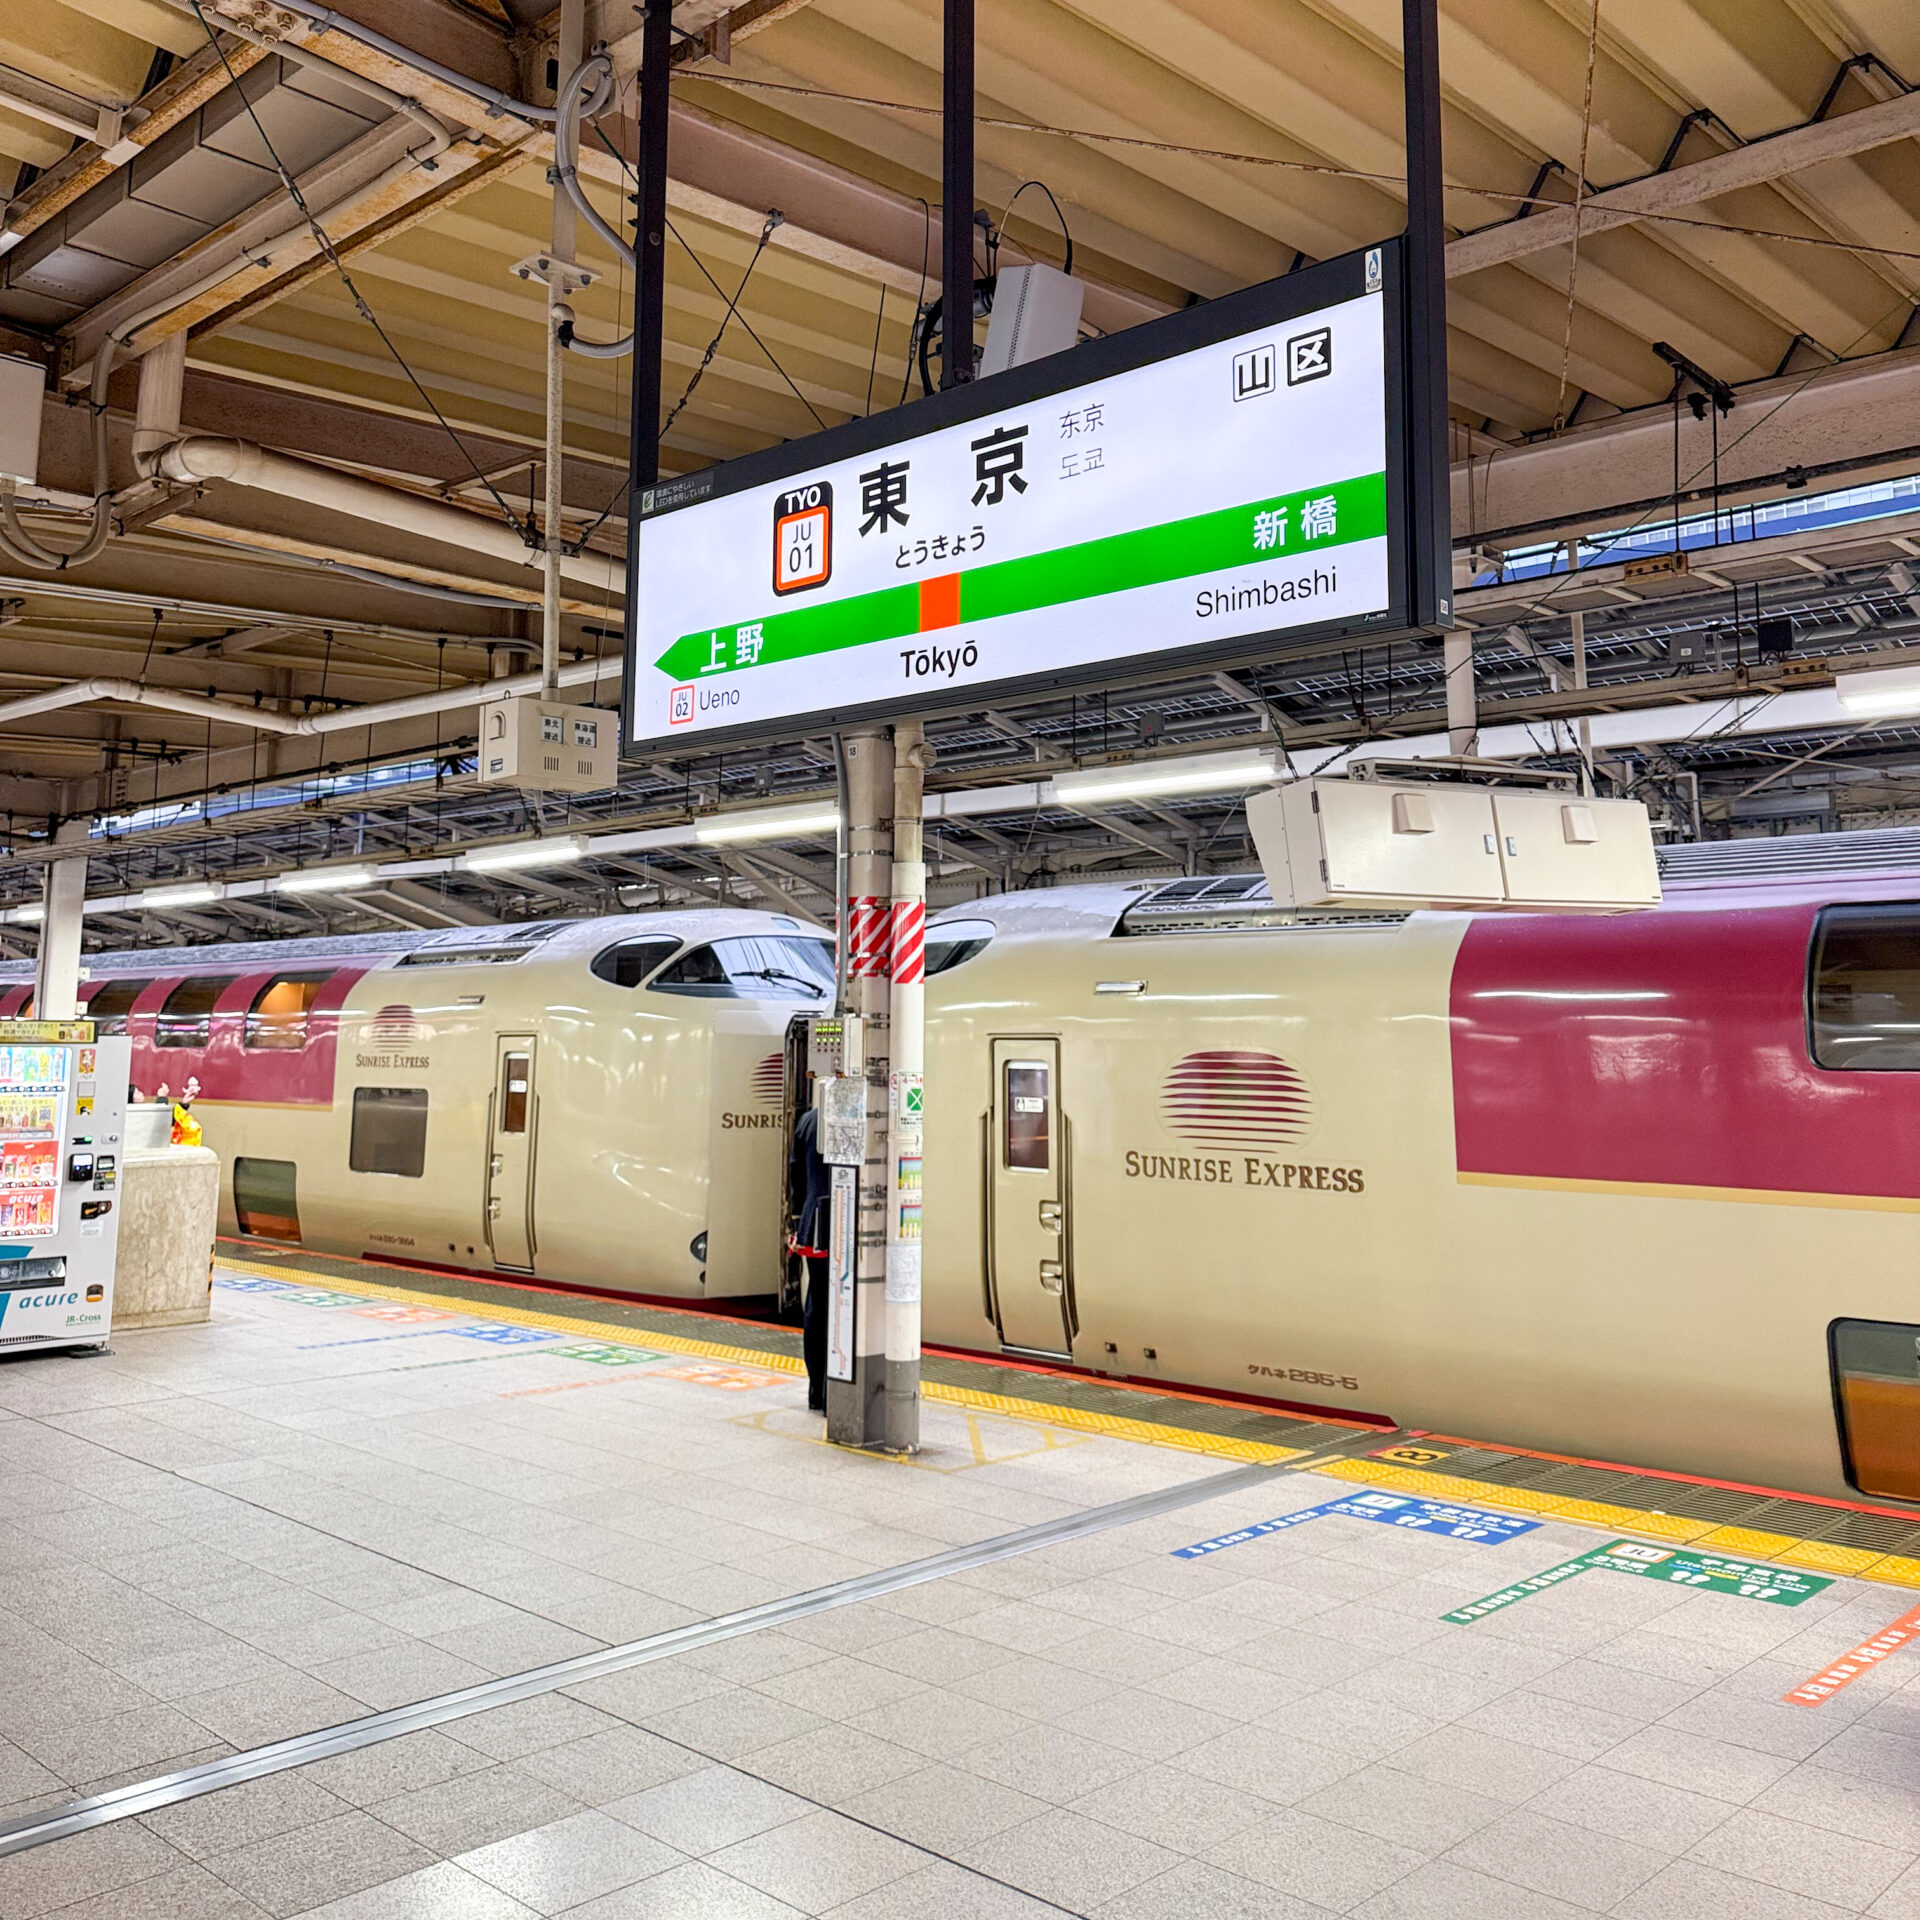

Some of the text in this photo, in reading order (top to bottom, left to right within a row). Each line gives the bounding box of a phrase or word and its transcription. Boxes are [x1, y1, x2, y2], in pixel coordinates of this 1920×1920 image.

[1238, 337, 1329, 396] 山 区
[1059, 402, 1105, 440] 东京
[1059, 448, 1106, 481] 도쿄
[858, 424, 1029, 538] 東京
[785, 486, 821, 513] TYO
[792, 521, 812, 542] JU
[1252, 494, 1338, 550] 新橋
[789, 545, 814, 573] 01
[895, 525, 987, 569] とうきょう
[1195, 565, 1338, 618] Shimbashi
[699, 622, 765, 674] 上野
[900, 639, 979, 679] Tōkyō
[675, 703, 689, 717] 02
[676, 692, 688, 702] JU
[699, 689, 741, 711] Ueno
[356, 1053, 430, 1069] SUNRISE EXPRESS
[1125, 1150, 1366, 1194] SUNRISE EXPRESS
[8, 1194, 44, 1204] acure
[18, 1292, 79, 1309] acure
[1247, 1363, 1359, 1391] クハネ285-5
[1622, 1548, 1659, 1558] JU
[1774, 1578, 1811, 1591] Line
